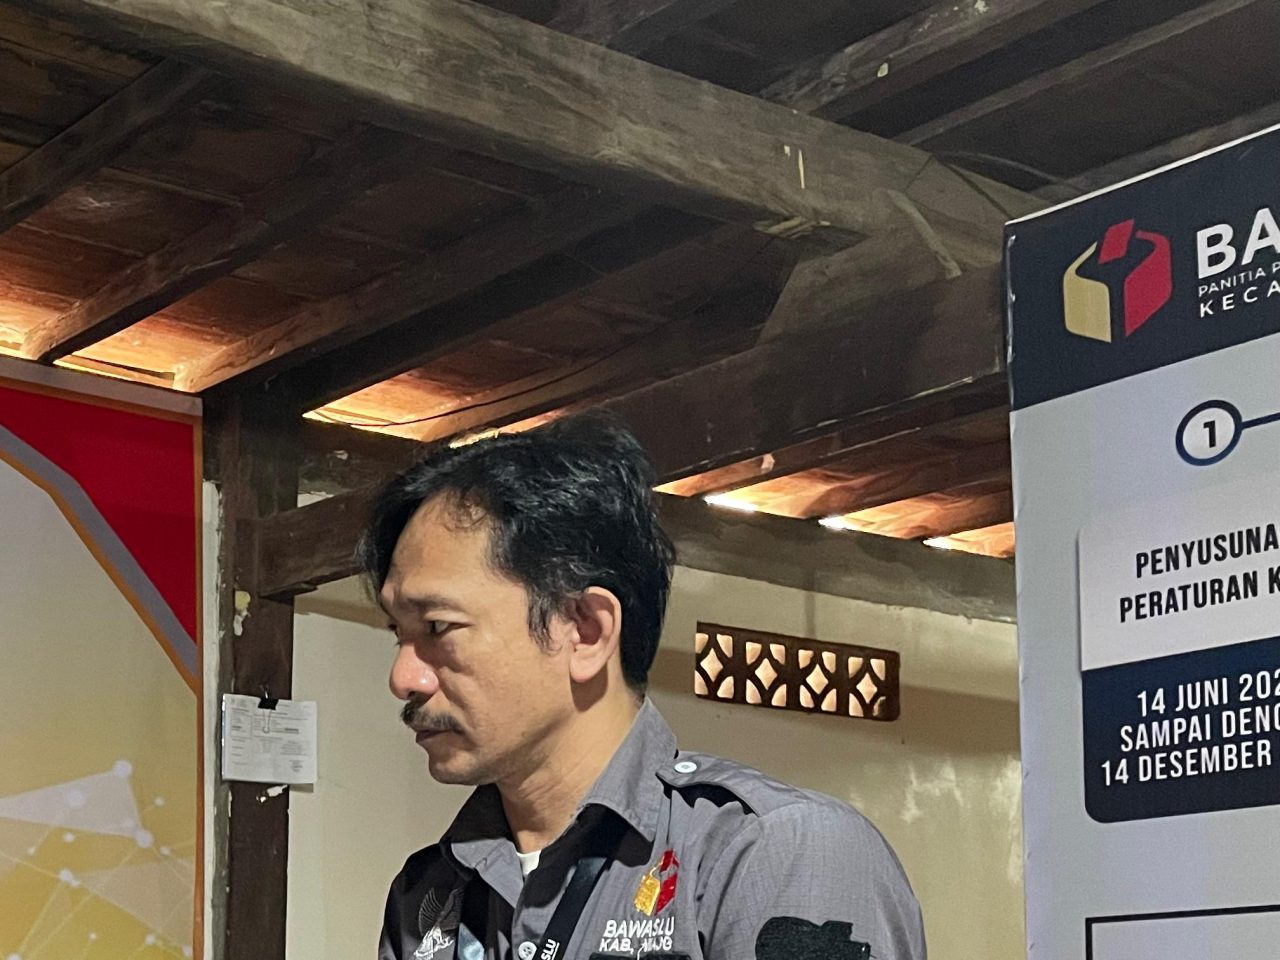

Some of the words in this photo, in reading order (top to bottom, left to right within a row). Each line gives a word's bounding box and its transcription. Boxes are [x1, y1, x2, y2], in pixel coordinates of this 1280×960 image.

[1196, 207, 1280, 280] BA
[1198, 267, 1267, 298] PANITIA
[1203, 421, 1217, 449] 1
[1136, 523, 1280, 579] PENYUSUNA
[1119, 570, 1258, 624] PERATURAN
[1136, 687, 1166, 718] 14
[1175, 677, 1228, 713] JUNI
[1120, 713, 1211, 753] SAMPAI
[1102, 756, 1129, 786] 14
[1138, 739, 1272, 784] DESEMBER
[603, 916, 675, 938] BAWASLU
